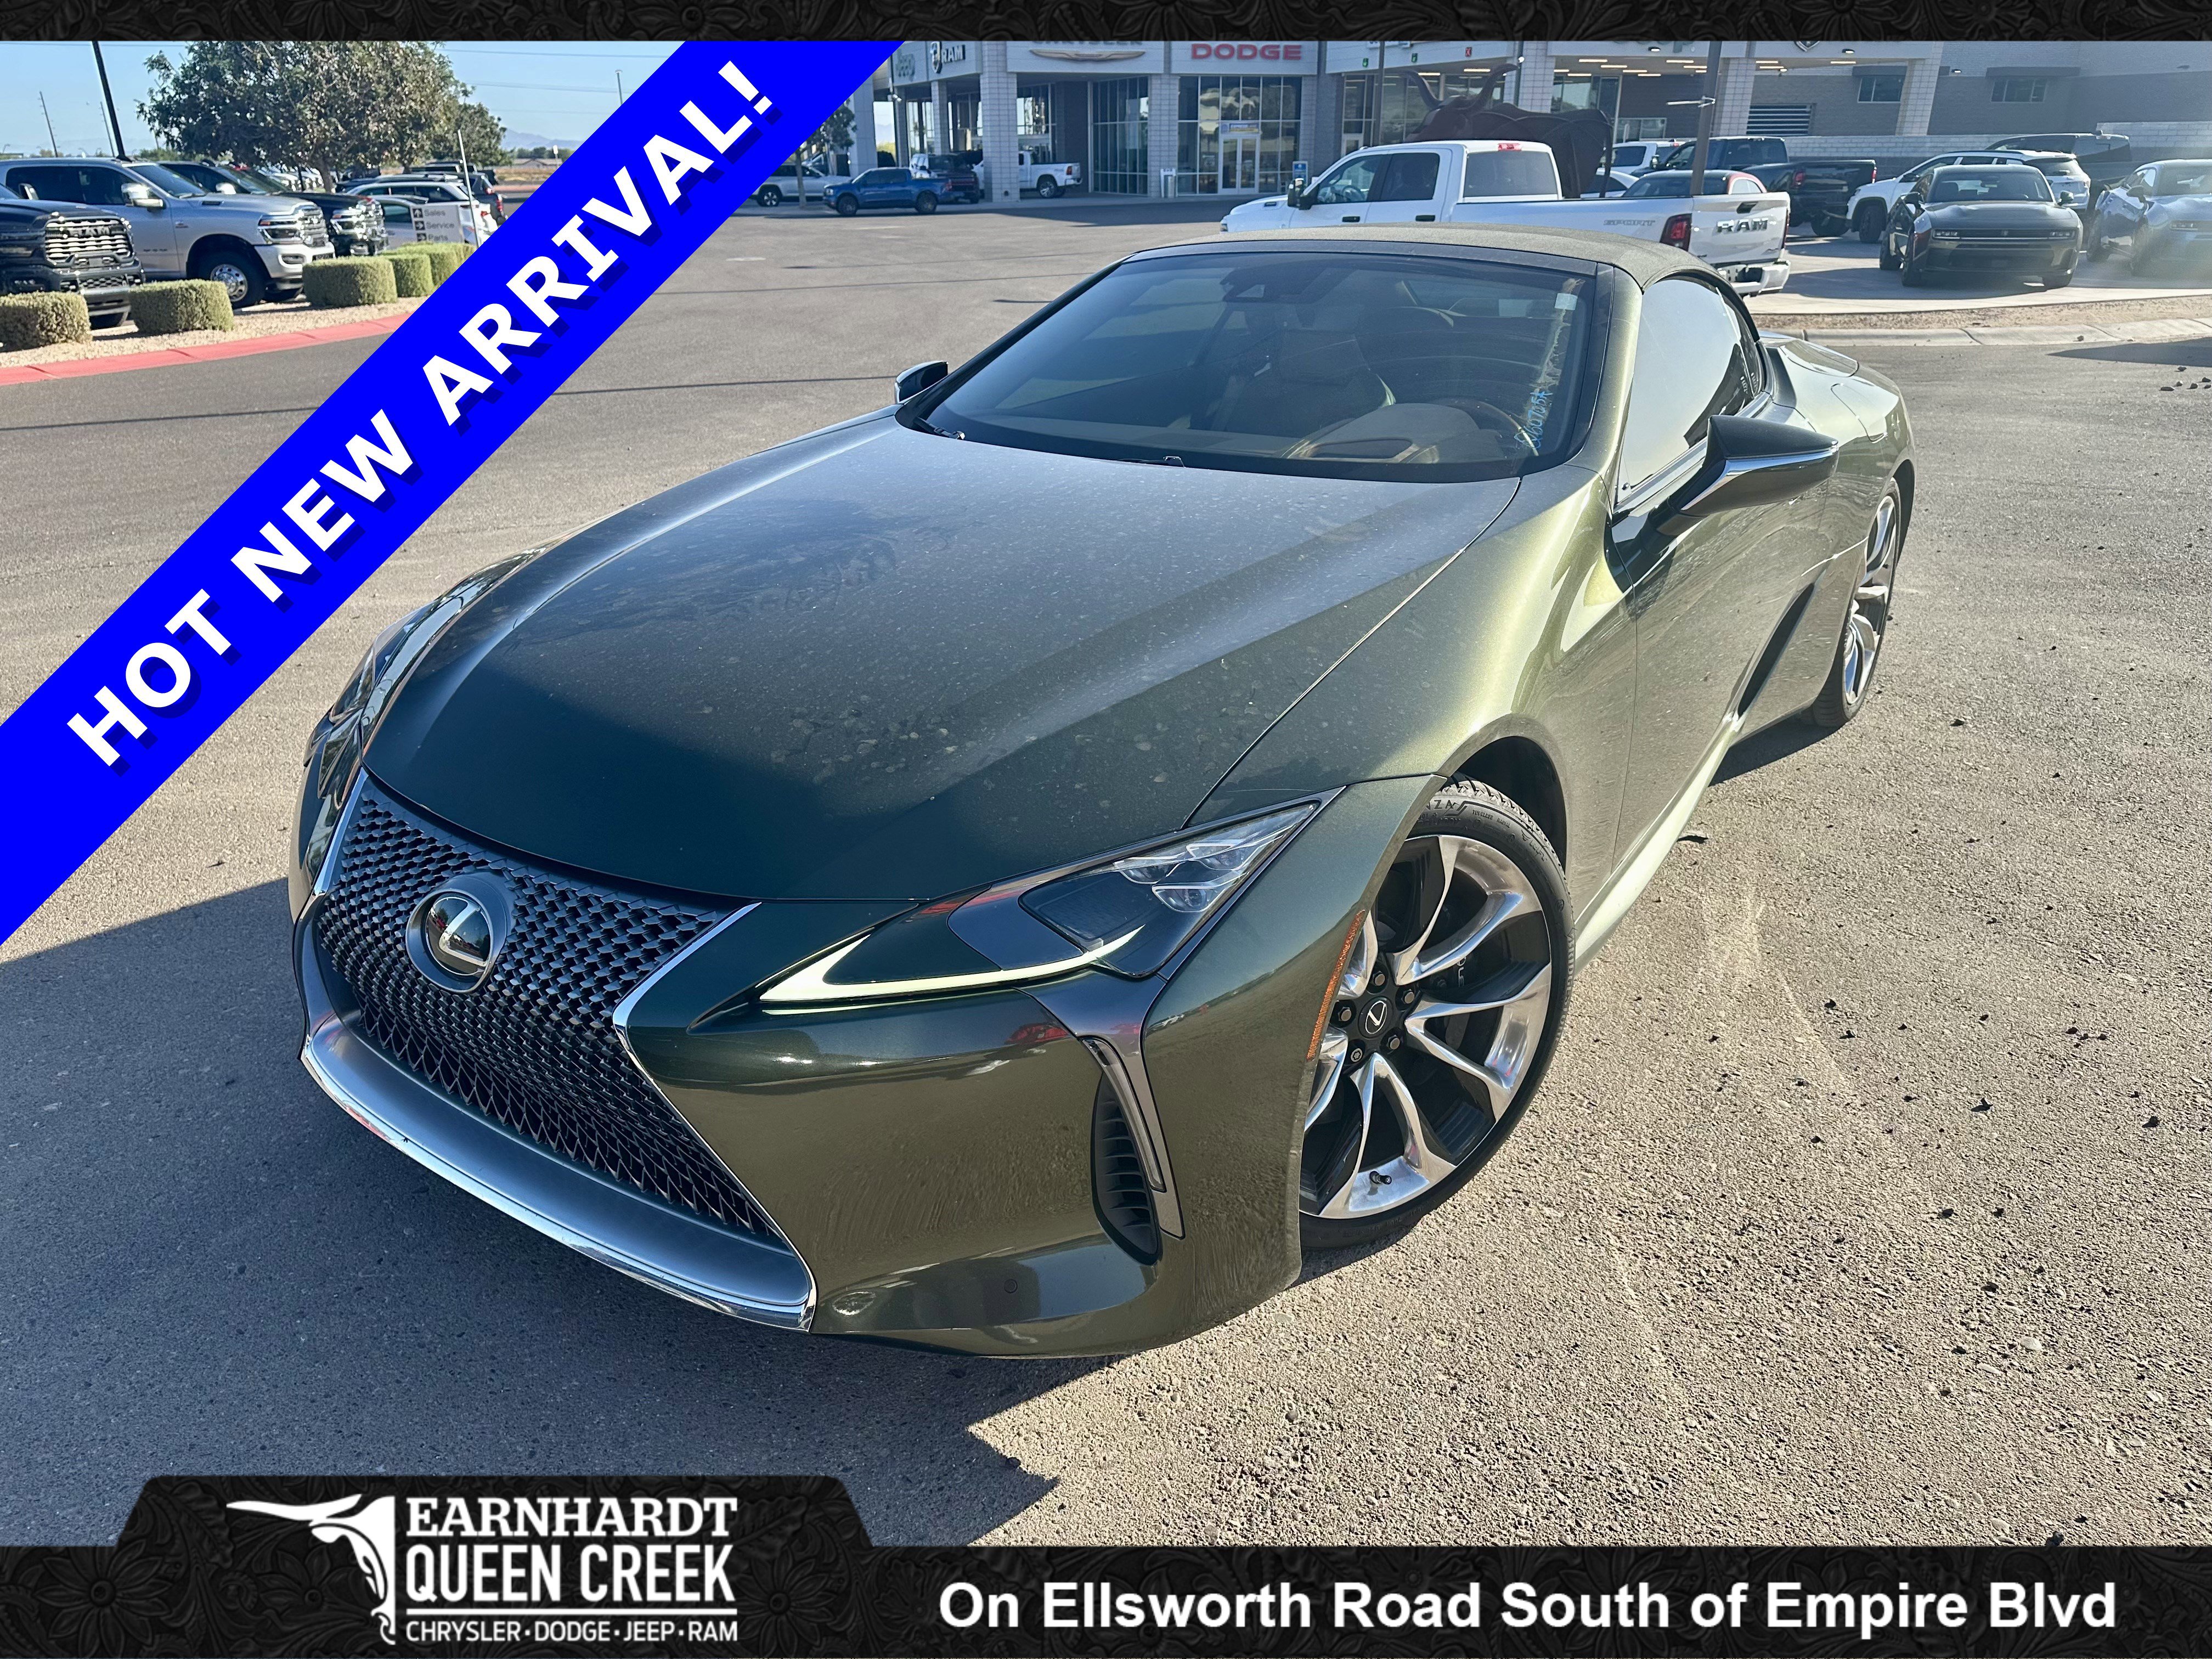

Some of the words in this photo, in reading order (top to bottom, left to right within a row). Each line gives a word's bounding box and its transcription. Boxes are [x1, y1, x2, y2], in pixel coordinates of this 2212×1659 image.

[941, 44, 966, 65] RAM
[1192, 43, 1302, 60] DODGE
[66, 225, 111, 238] RAM
[1714, 218, 1769, 234] RAM
